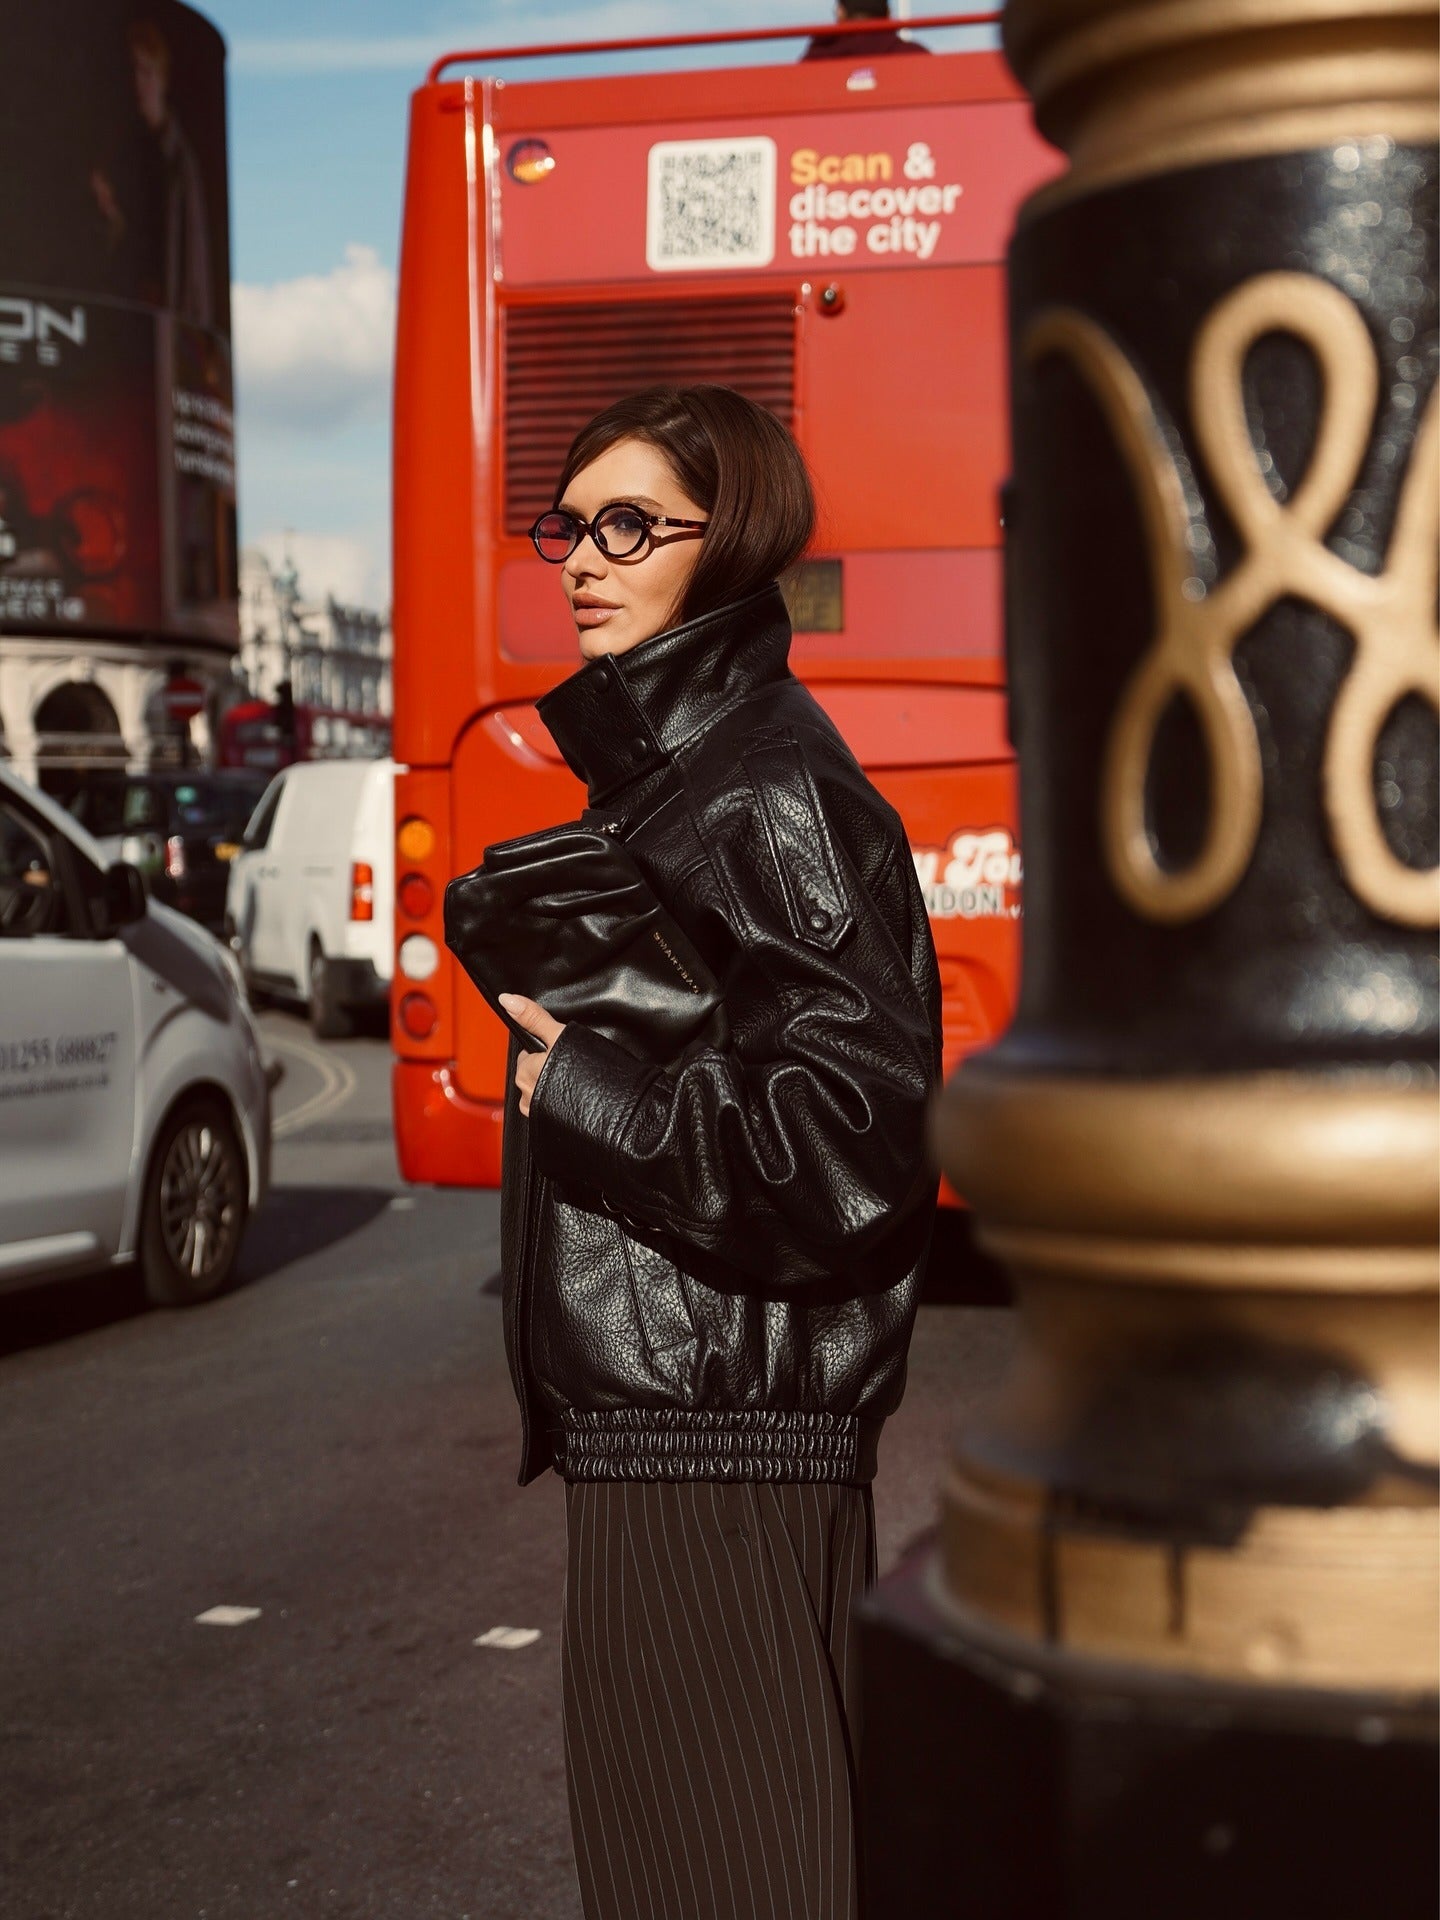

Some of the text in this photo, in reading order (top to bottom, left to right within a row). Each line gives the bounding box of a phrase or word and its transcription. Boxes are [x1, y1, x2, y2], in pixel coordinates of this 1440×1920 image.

[790, 142, 935, 183] Scan &
[789, 182, 963, 221] discover
[789, 216, 941, 260] the city
